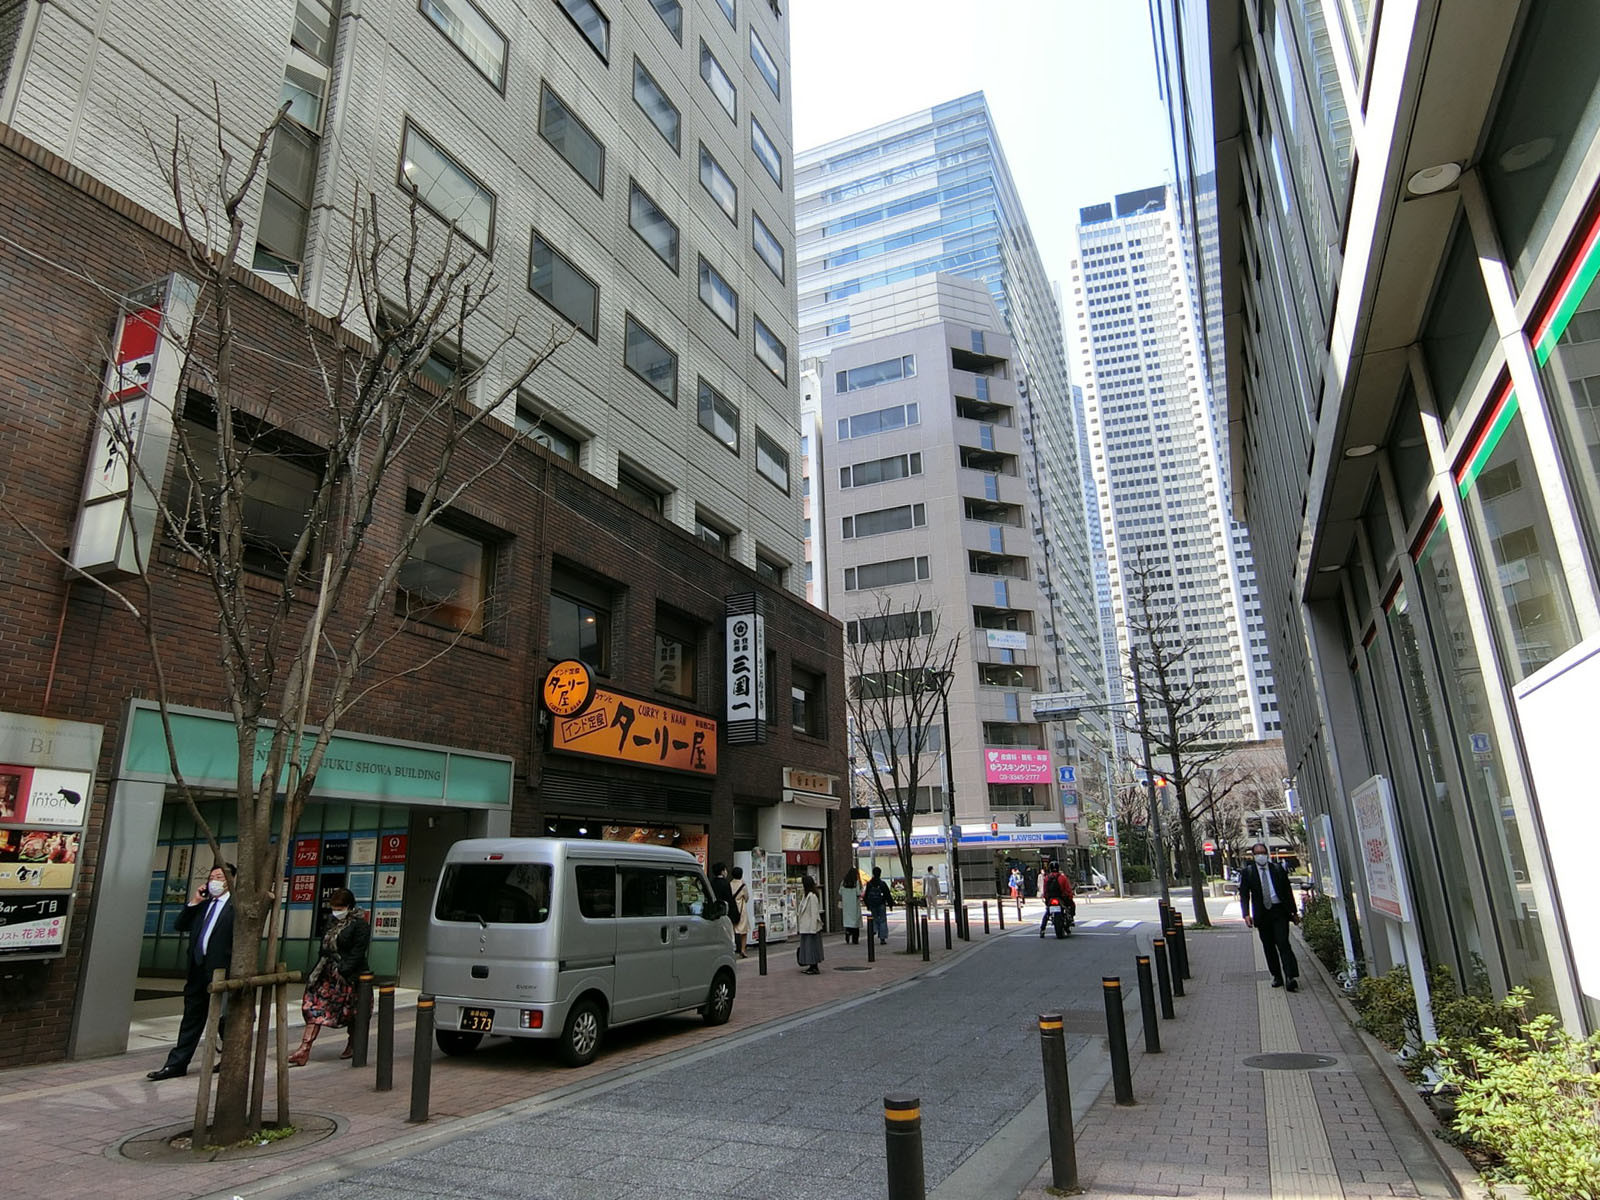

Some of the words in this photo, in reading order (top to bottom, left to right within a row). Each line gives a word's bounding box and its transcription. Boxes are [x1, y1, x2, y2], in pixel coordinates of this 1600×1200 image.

[548, 677, 586, 694] ターリー
[732, 655, 751, 711] 三国一
[558, 690, 569, 706] 屋
[638, 705, 659, 719] CURRY
[663, 711, 668, 722] &
[671, 713, 687, 726] NAAN
[565, 713, 605, 737] インド定食
[610, 701, 706, 769] ターリー屋
[356, 763, 393, 776] SHOWA
[395, 767, 442, 781] BUILDING
[990, 763, 1047, 772] ゆうスキンクリニック
[1010, 833, 1042, 842] LAWSON
[22, 900, 58, 915] 一丁目
[22, 927, 59, 940] 花泥棒
[471, 1017, 492, 1031] 373
